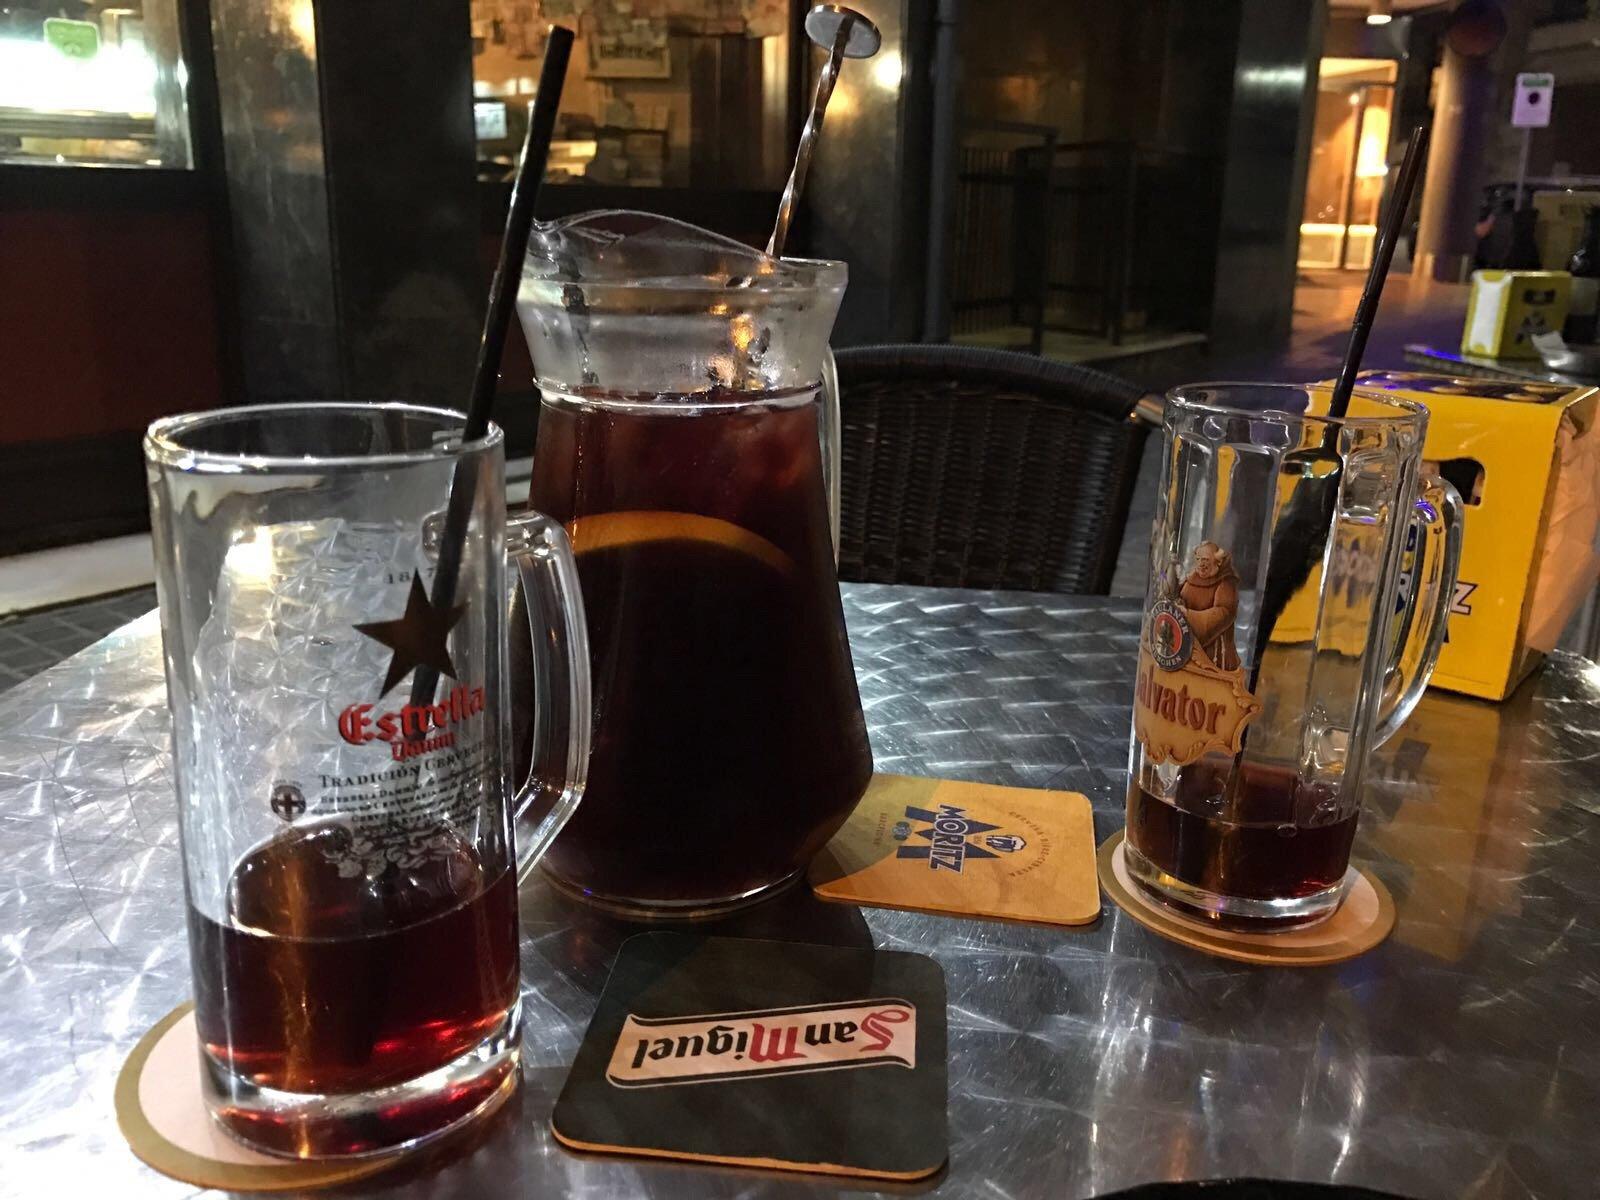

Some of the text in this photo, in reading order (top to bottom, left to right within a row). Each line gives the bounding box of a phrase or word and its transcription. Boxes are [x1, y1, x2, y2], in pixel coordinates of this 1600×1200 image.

[1153, 603, 1189, 634] AULANER
[338, 685, 485, 745] Estrella
[1137, 664, 1226, 734] alvator
[929, 803, 970, 875] MORITZ
[631, 1008, 911, 1069] San Miguel
